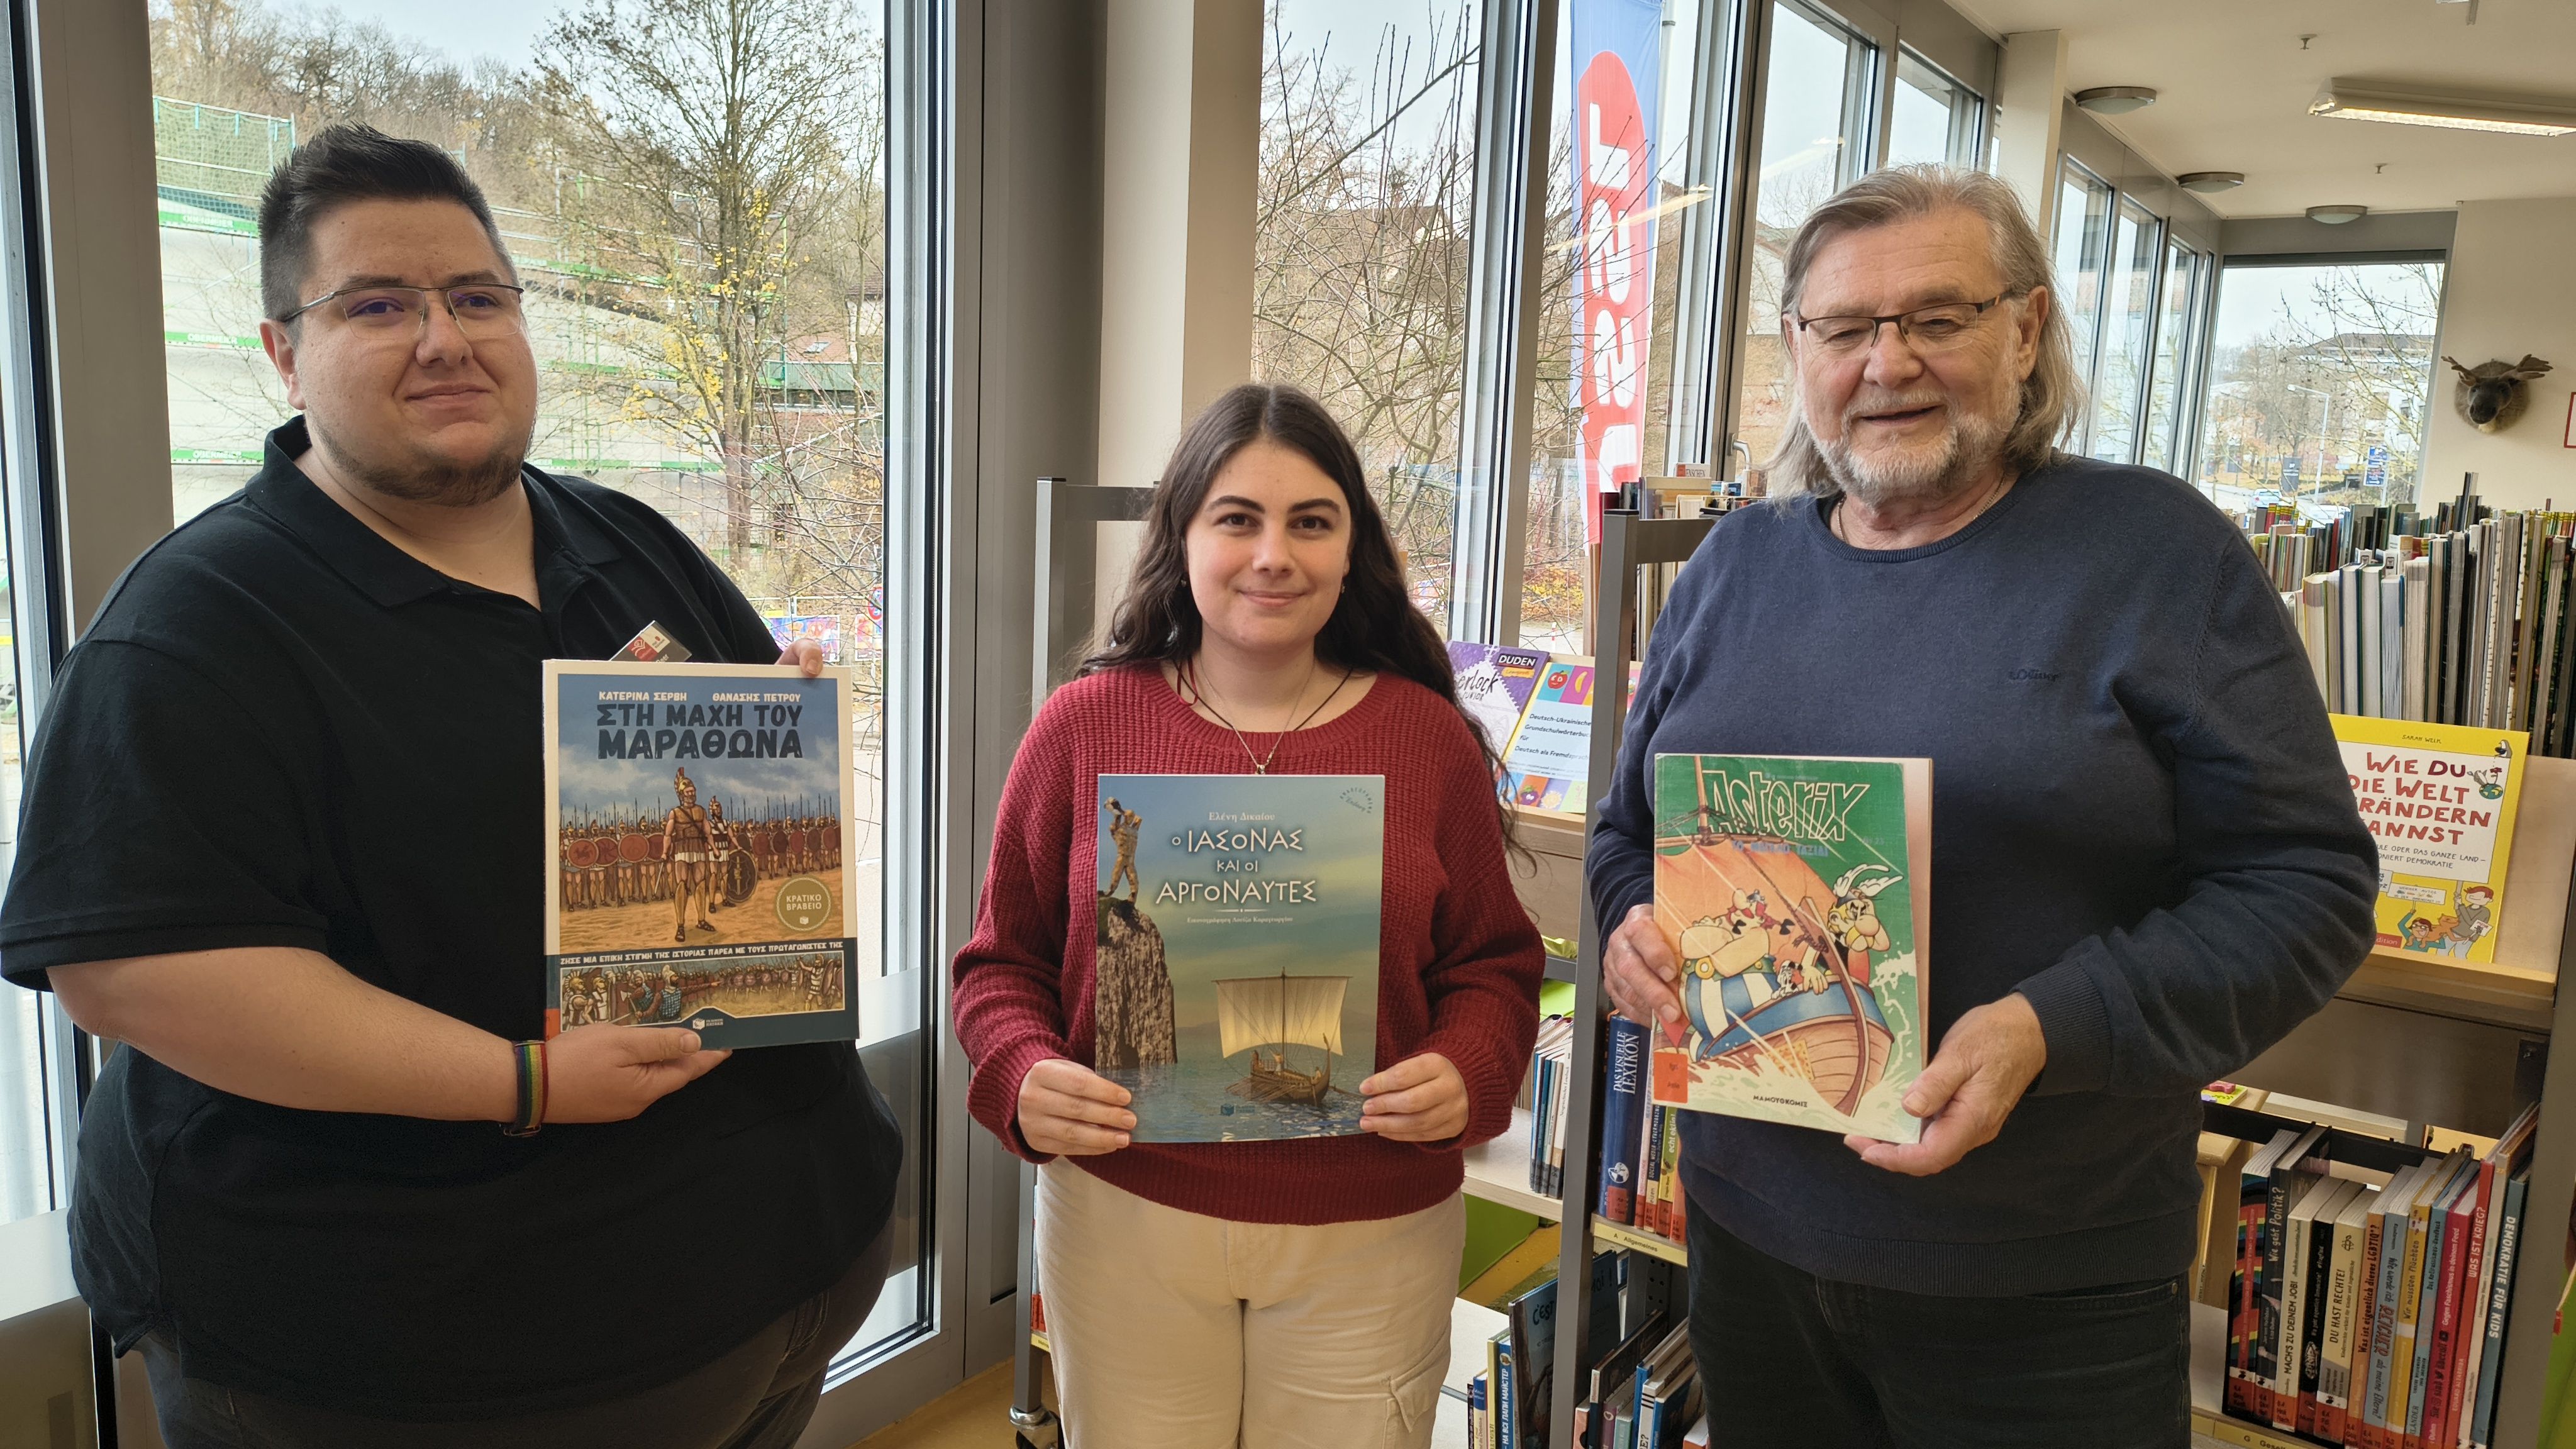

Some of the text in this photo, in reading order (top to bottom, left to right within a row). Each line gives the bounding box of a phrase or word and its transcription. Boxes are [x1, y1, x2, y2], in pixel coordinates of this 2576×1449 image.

[1499, 655, 1536, 667] DUDEN
[1458, 669, 1498, 694] erlock
[599, 691, 687, 701] ΚΑΤΕΡΙΝΑ ΣΕΡΒΗ
[712, 693, 801, 703] ΘΑΝΑΣΗΣ ΠΕΤΡΟΥ
[597, 704, 803, 727] ΣΤΗ ΜΑΧΗ ΤΟΥ
[1530, 713, 1591, 726] Deutsch-Ukrainische
[1525, 724, 1590, 737] Grundschulwörterbuc
[598, 729, 803, 759] ΜΑΡΑΘΩΝΑ
[1550, 751, 1588, 760] Fremdsprach
[2367, 752, 2466, 778] WIE DU
[2396, 777, 2470, 804] WELT
[1702, 770, 1871, 841] Asterix
[2358, 797, 2491, 828] RÄNDERN
[1209, 812, 1275, 822] Ελένη Δικαίου
[1188, 827, 1303, 852] ΙΑΣΟΝΑΣ
[2367, 820, 2464, 845] ANNST
[2378, 853, 2453, 869] ONIERT DEMOKRATIE
[2431, 851, 2457, 860] GANZE
[787, 894, 821, 902] ΚΡΑΤΙΚΟ
[1156, 879, 1317, 904] ΑΡΓΟΝΑΥΤΕΣ
[787, 902, 821, 911] ΒΡΑΒΕΙΟ
[2376, 936, 2398, 946] dition
[560, 957, 580, 965] ΖΗΣΕ
[599, 954, 623, 962] ΕΠΙΚΗ
[625, 952, 652, 960] ΣΤΙΓΜΗ
[672, 949, 706, 957] ΙΣΤΟΡΙΑΣ
[708, 948, 733, 956] ΠΑΡΕΑ
[1614, 1031, 1626, 1092] DAS VISUELLE
[1621, 1033, 1640, 1095] LEXIKON
[2268, 1187, 2285, 1262] Wie geht Politik?
[2473, 1207, 2486, 1239] KRIEG?
[1624, 1236, 1658, 1252] Allgemeines
[2471, 1241, 2481, 1256] IST
[2389, 1257, 2398, 1269] Wie
[2468, 1259, 2479, 1278] WAS
[2365, 1263, 2376, 1287] dieses
[2385, 1270, 2396, 1288] werde
[2403, 1240, 2420, 1319] Wir mussten flüchten
[2489, 1216, 2516, 1338] DEMOKRATIE FÜR KIDS
[2289, 1281, 2298, 1299] JOB!
[2384, 1289, 2394, 1302] ich
[2445, 1271, 2455, 1305] Faschismus
[2287, 1300, 2296, 1331] DEINEM
[2329, 1269, 2345, 1343] DU HAST RECHTE!
[2362, 1288, 2373, 1325] eigentlich
[2286, 1333, 2294, 1344] ZU
[2360, 1326, 2369, 1340] ist
[2374, 1304, 2395, 1357] REICHER
[2358, 1341, 2367, 1353] Was
[2284, 1345, 2293, 1374] MACH'S
[2377, 1359, 2387, 1369] als
[2374, 1370, 2384, 1391] meine
[2372, 1393, 2384, 1419] Eltern?
[2452, 1385, 2461, 1411] EDUARD
[1502, 1435, 1509, 1445] НА
